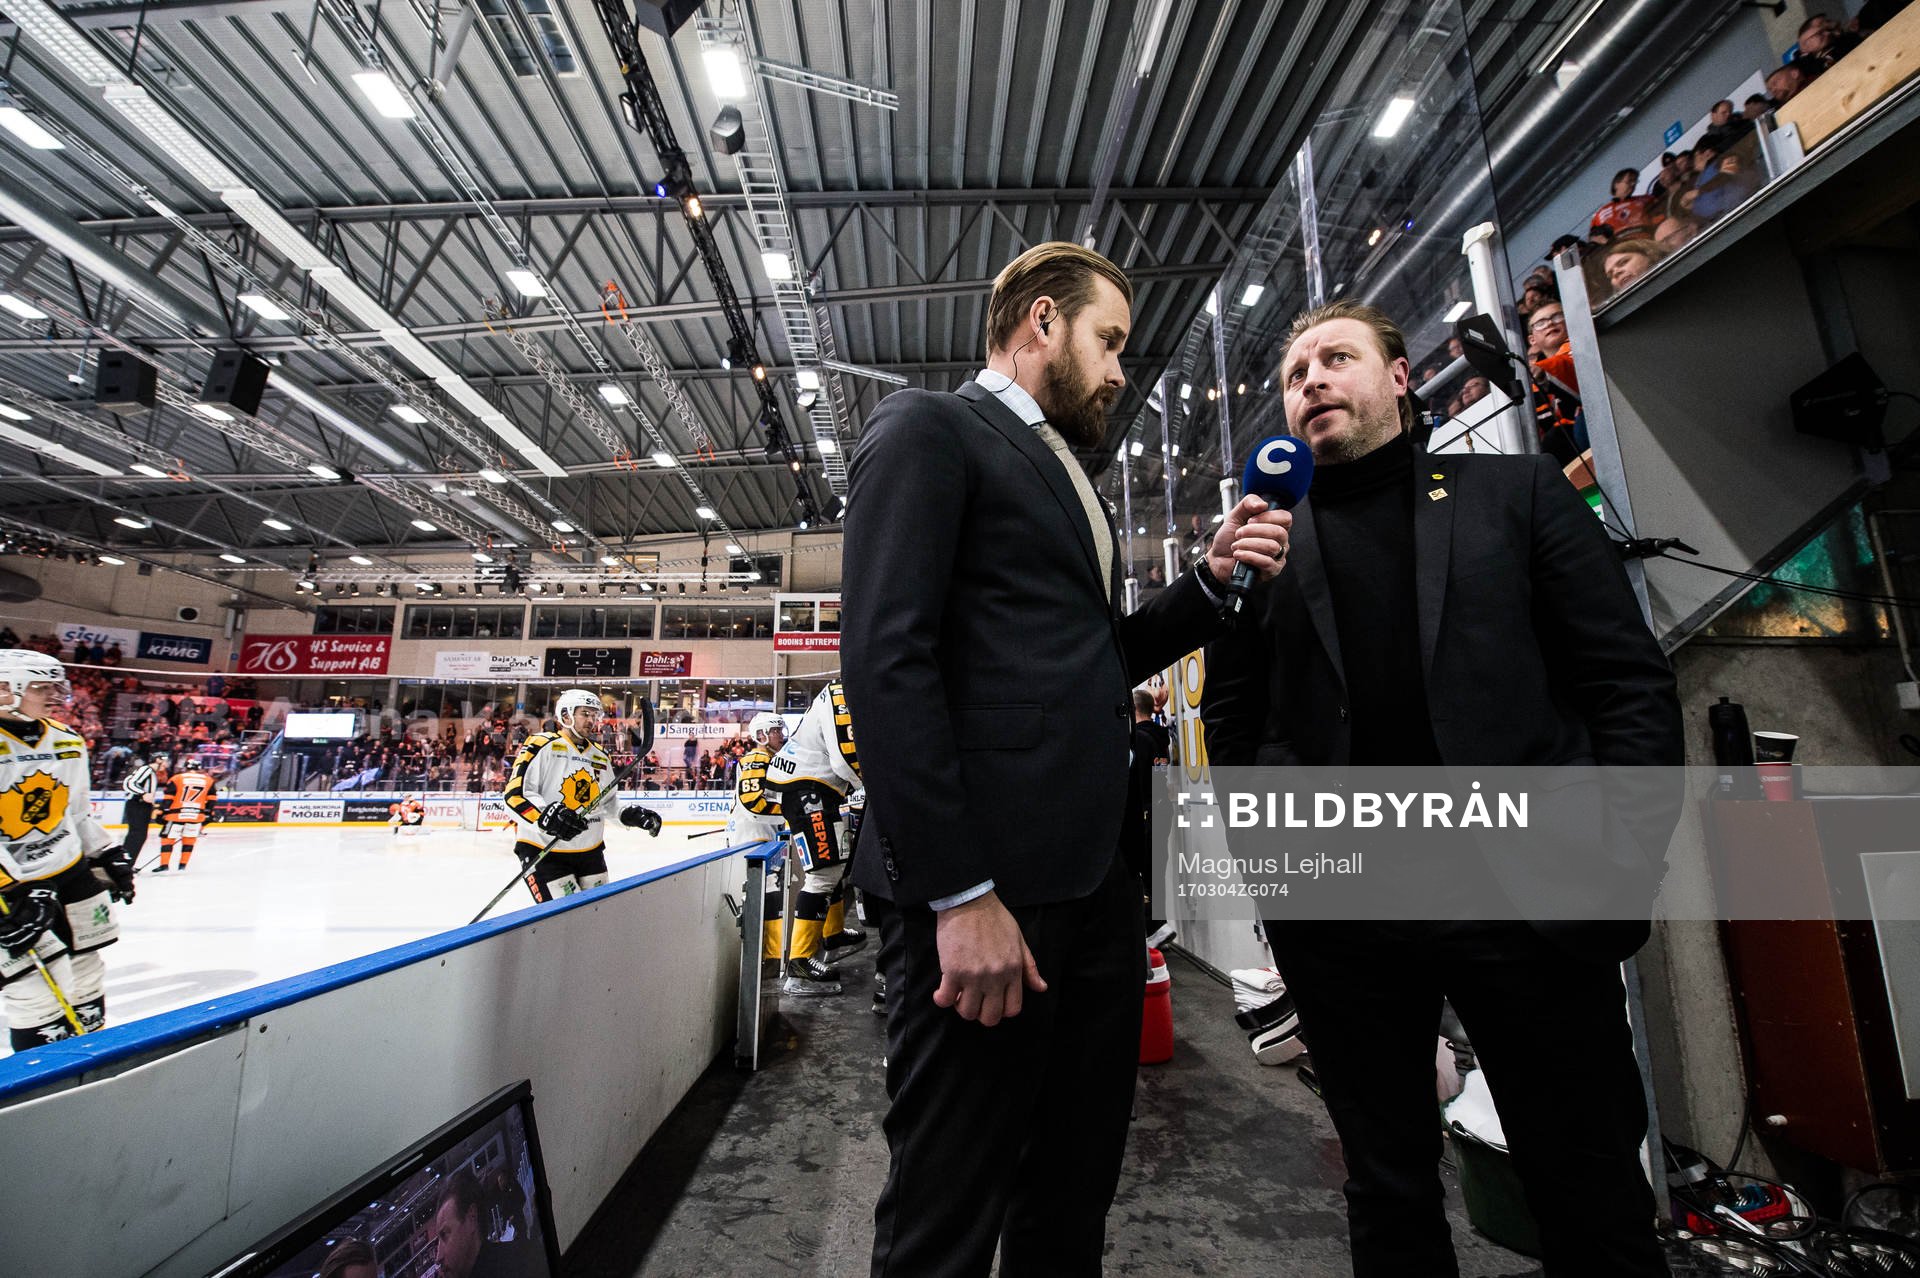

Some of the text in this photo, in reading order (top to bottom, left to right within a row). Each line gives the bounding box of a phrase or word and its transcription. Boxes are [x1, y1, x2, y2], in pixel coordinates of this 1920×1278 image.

[310, 640, 385, 653] HS Service &
[778, 638, 803, 646] BODINS
[147, 645, 200, 659] KPMG
[309, 657, 381, 672] Support AB
[742, 779, 760, 793] 63
[182, 785, 203, 802] 17
[698, 802, 730, 811] STENA
